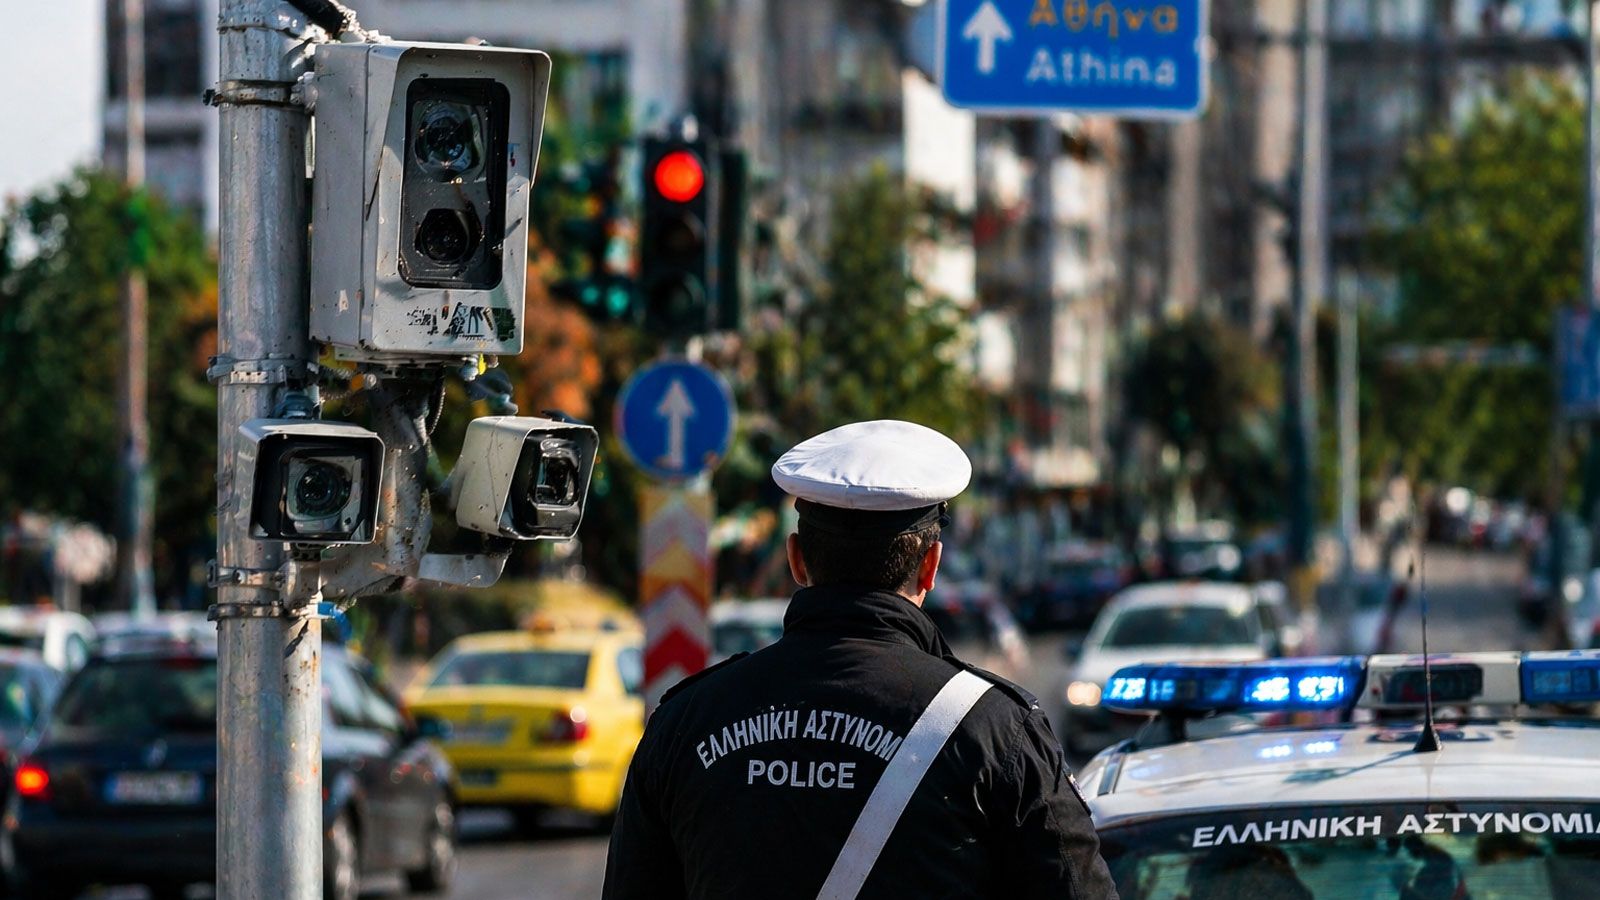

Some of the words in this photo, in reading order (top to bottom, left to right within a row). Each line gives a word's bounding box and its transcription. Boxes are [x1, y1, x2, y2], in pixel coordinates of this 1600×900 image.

[1027, 48, 1176, 86] Athina
[696, 710, 799, 770] ΕΛΛΗΝΙΚΗ
[747, 759, 857, 789] POLICE
[1192, 815, 1382, 848] ΕΛΛΗΝΙΚΗ
